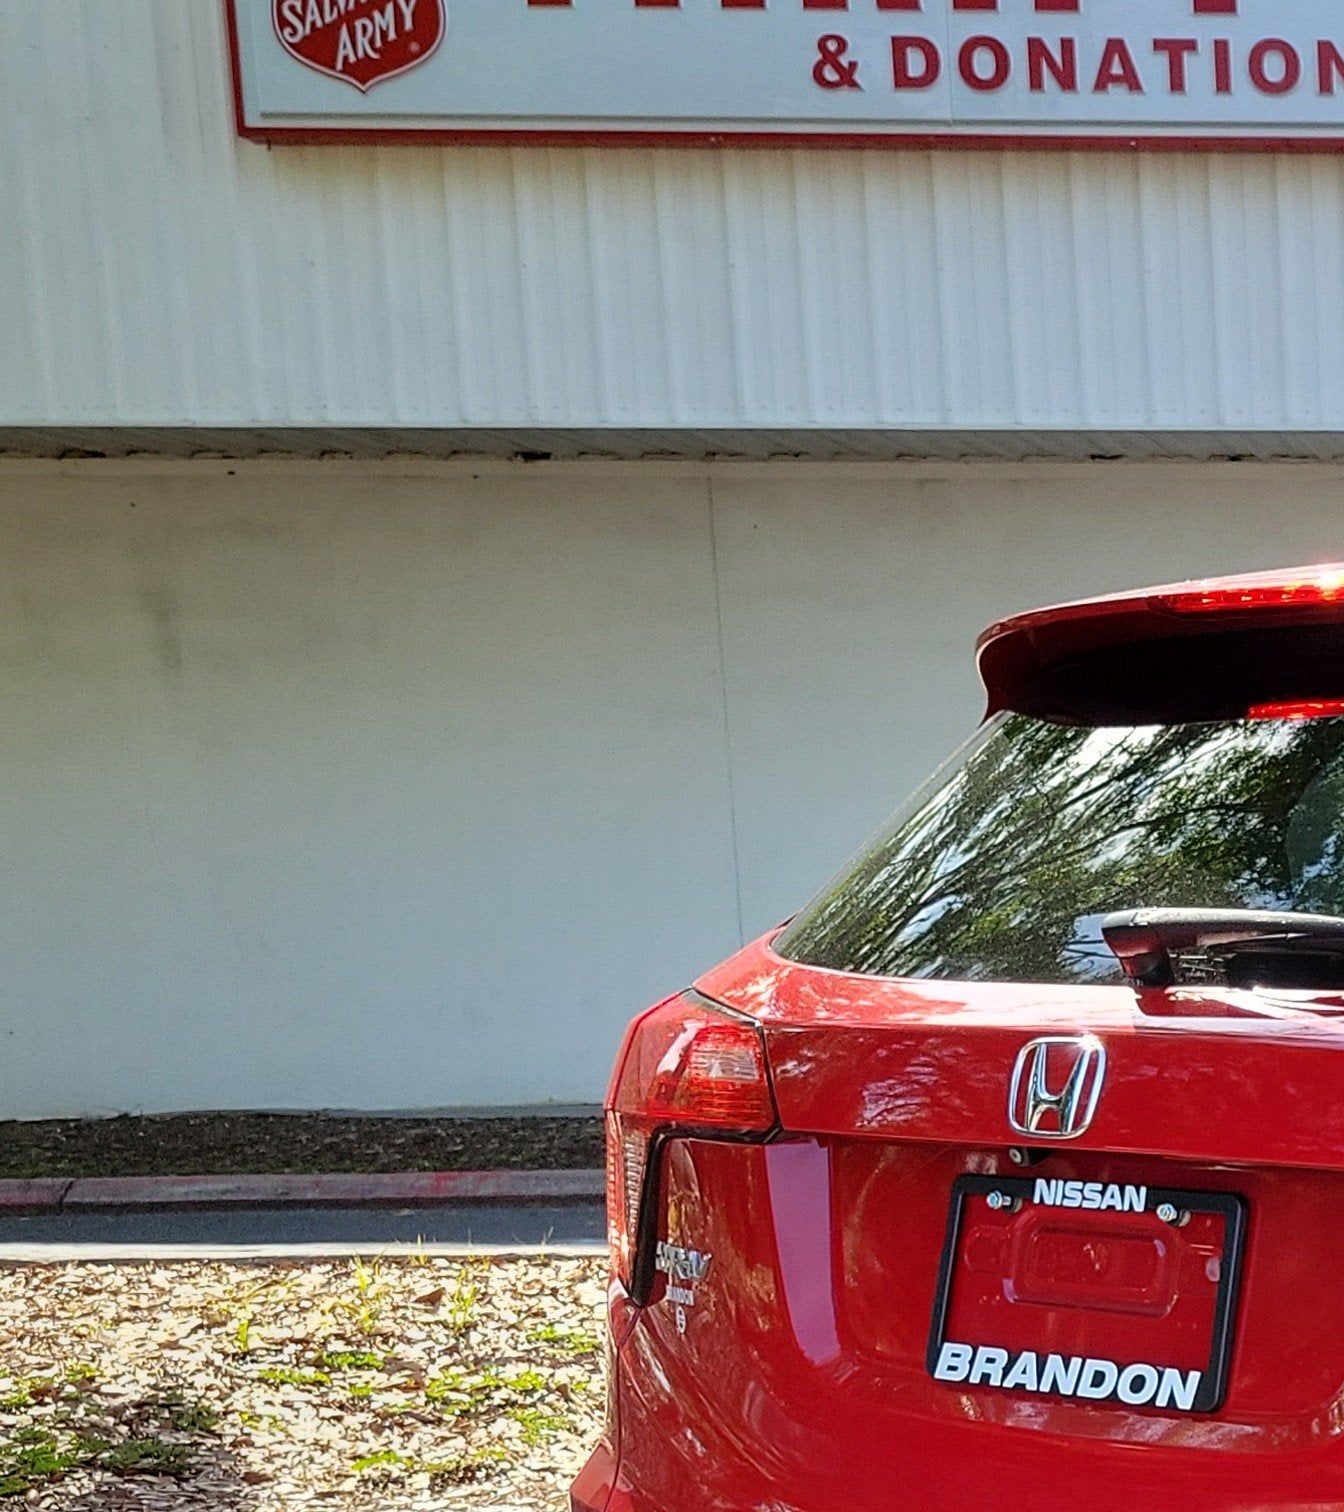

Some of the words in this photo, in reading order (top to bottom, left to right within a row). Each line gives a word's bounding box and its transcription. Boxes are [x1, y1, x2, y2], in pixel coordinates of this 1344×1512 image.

[335, 0, 417, 71] ARMY
[811, 33, 862, 91] &
[1033, 1178, 1147, 1212] NISSAN
[933, 1342, 1201, 1411] BRANDON
